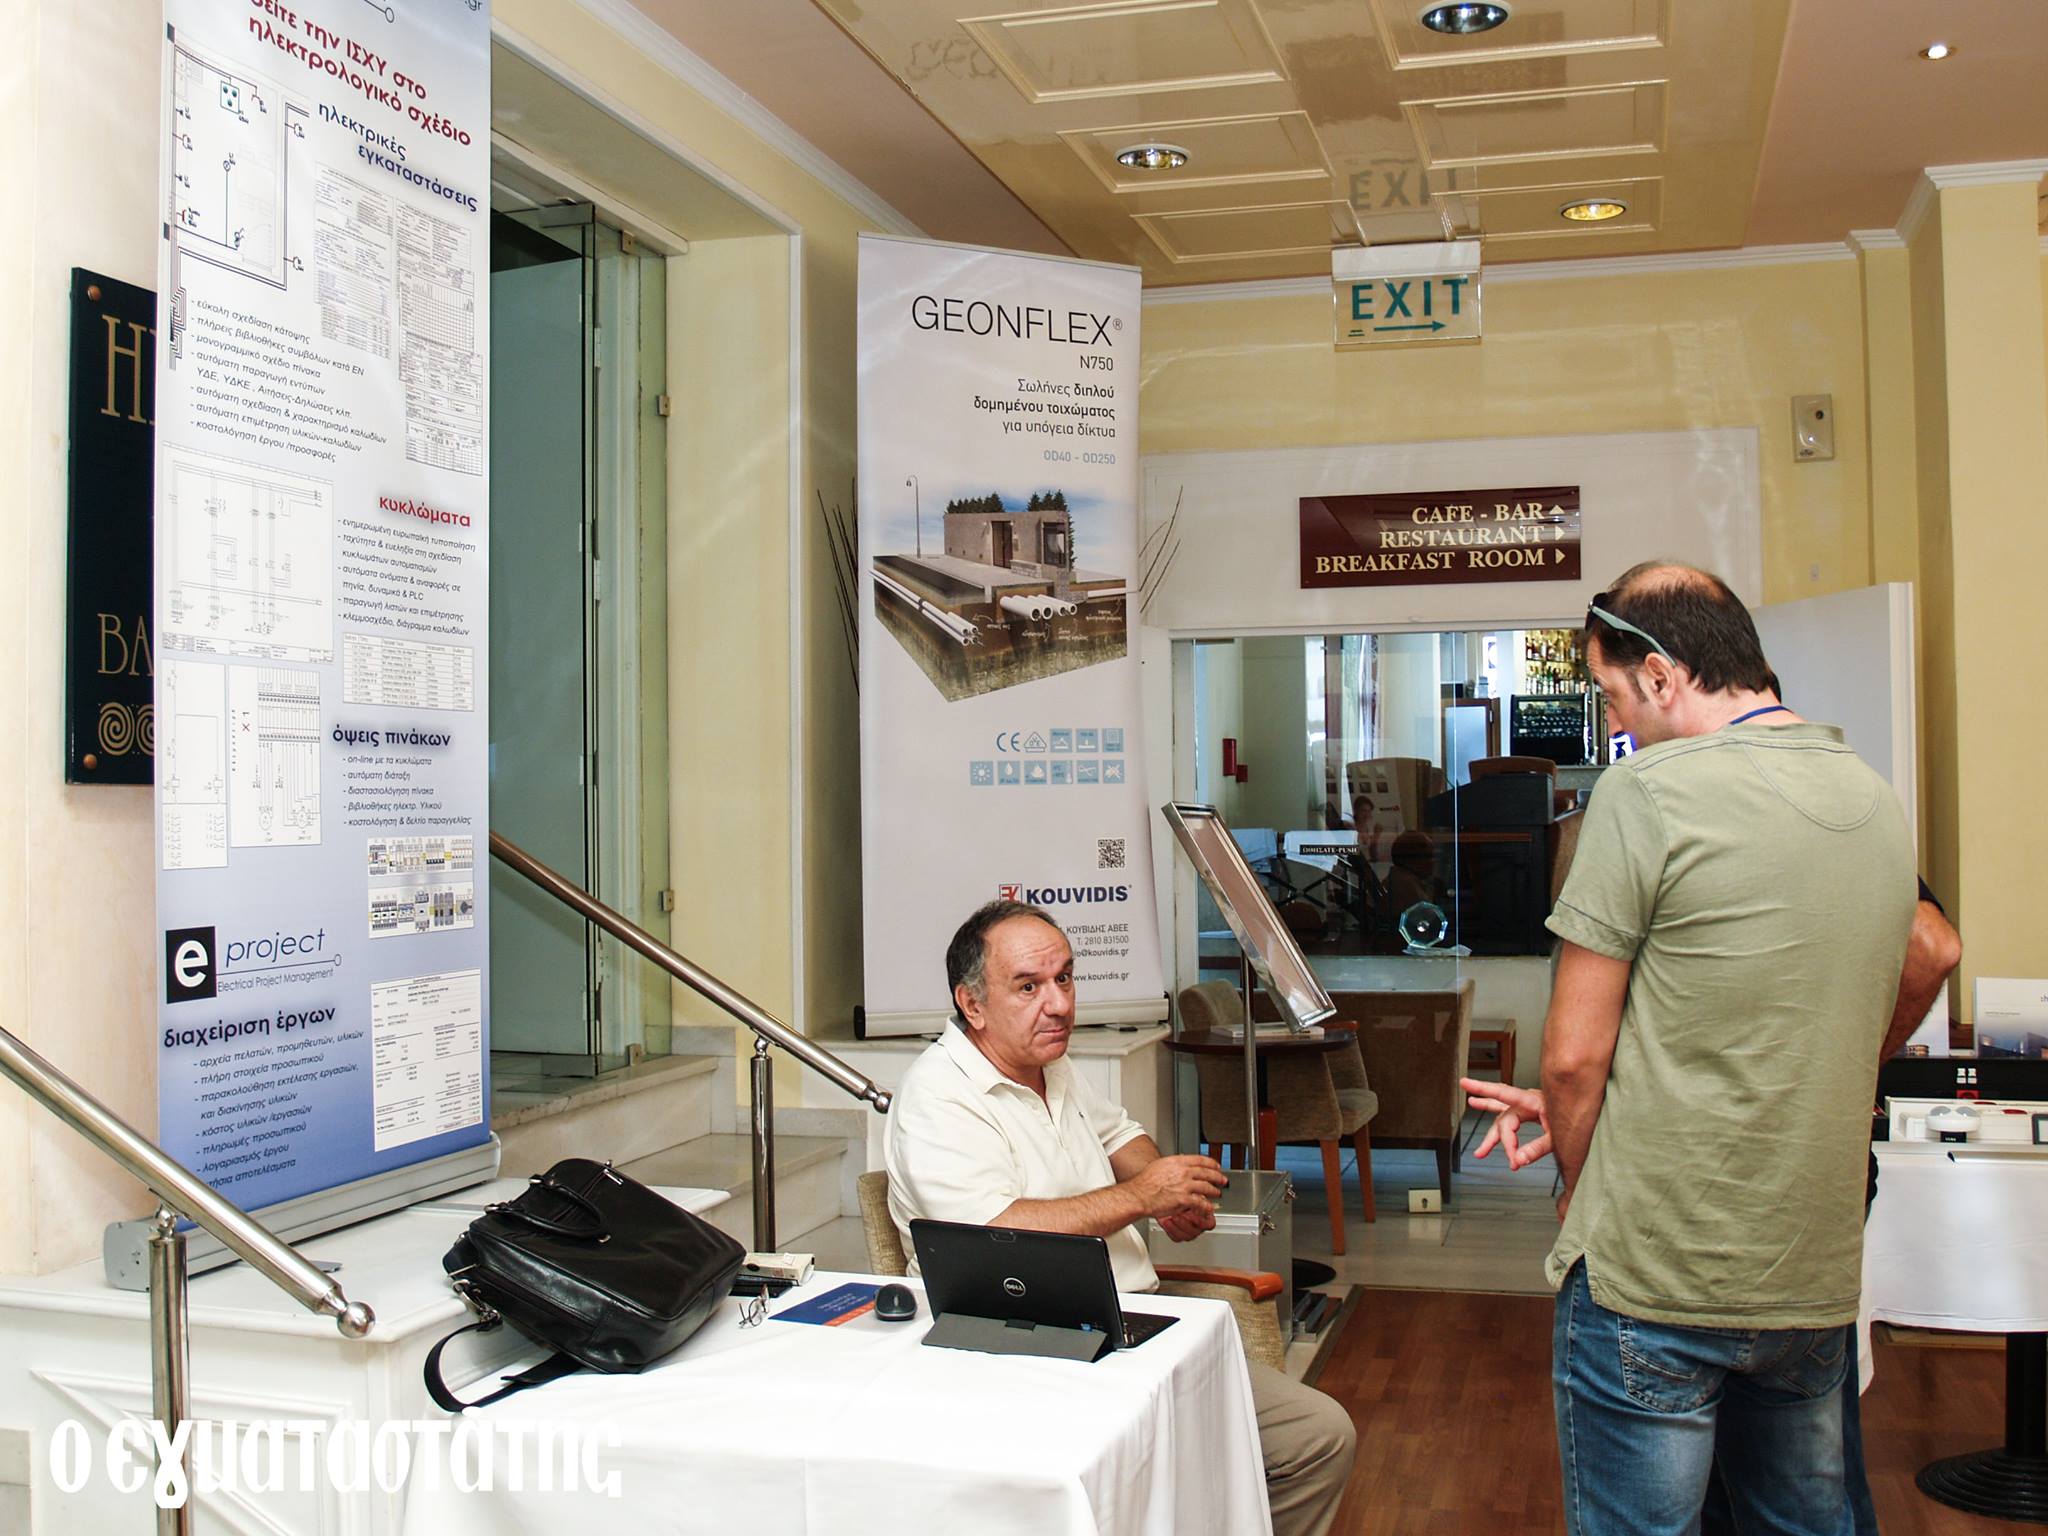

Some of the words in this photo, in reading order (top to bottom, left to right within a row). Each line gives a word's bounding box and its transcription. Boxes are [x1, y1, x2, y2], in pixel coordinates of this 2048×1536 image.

[304, 20, 340, 49] την
[347, 39, 387, 76] ΙΣΧΥ
[393, 71, 427, 100] στο
[250, 17, 402, 111] ηλεκτρολογικό
[408, 106, 471, 145] σχέδιο
[319, 103, 406, 160] ηλεκτρικές
[358, 144, 477, 212] εγκαταστάσεις
[197, 300, 229, 319] εύκολη
[1352, 278, 1468, 320] EXIT
[197, 317, 233, 337] πλήρεις
[235, 326, 285, 353] βιβλιοθήκες
[197, 335, 260, 360] μονογραμμικό
[262, 354, 290, 369] σχέδιο
[293, 363, 321, 378] πίνακα
[1079, 354, 1114, 371] N750
[197, 351, 239, 371] αυτόματη
[242, 364, 288, 386] παραγωγή
[289, 378, 325, 396] εντύπων
[197, 386, 239, 406] αυτόματη
[1017, 378, 1071, 398] Σωλήνες
[1073, 383, 1114, 399] διπλού
[197, 403, 239, 423] αυτόματη
[973, 396, 1043, 413] δομημένου
[1048, 402, 1115, 420] τοιχώματος
[197, 420, 257, 443] κοστολόγηση
[259, 436, 289, 450] έργου
[1003, 420, 1022, 434] για
[1026, 421, 1074, 436] υπόγεια
[1077, 424, 1116, 438] δίκτυα
[1043, 450, 1071, 462] OD40
[1083, 453, 1116, 465] OD250
[380, 497, 471, 527] κυκλώματα
[1411, 506, 1473, 525] CAFE
[1494, 503, 1544, 522] BAR
[1380, 526, 1544, 548] RESTAURANT
[1316, 552, 1455, 574] BREAKFAST
[1468, 548, 1545, 568] ROOM
[409, 591, 424, 600] PLC
[333, 724, 379, 747] όψεις
[385, 728, 452, 746] πινάκων
[1027, 886, 1128, 904] KOUVIDIS
[1085, 937, 1101, 945] 2810
[1104, 935, 1129, 944] 831500
[175, 940, 208, 987] e
[226, 928, 325, 968] project
[218, 974, 253, 992] Electrical
[255, 973, 282, 987] Project
[284, 968, 333, 984] Management
[164, 1018, 270, 1047] διαχείριση
[276, 1007, 336, 1030] έργων
[207, 1175, 233, 1190] τήσια
